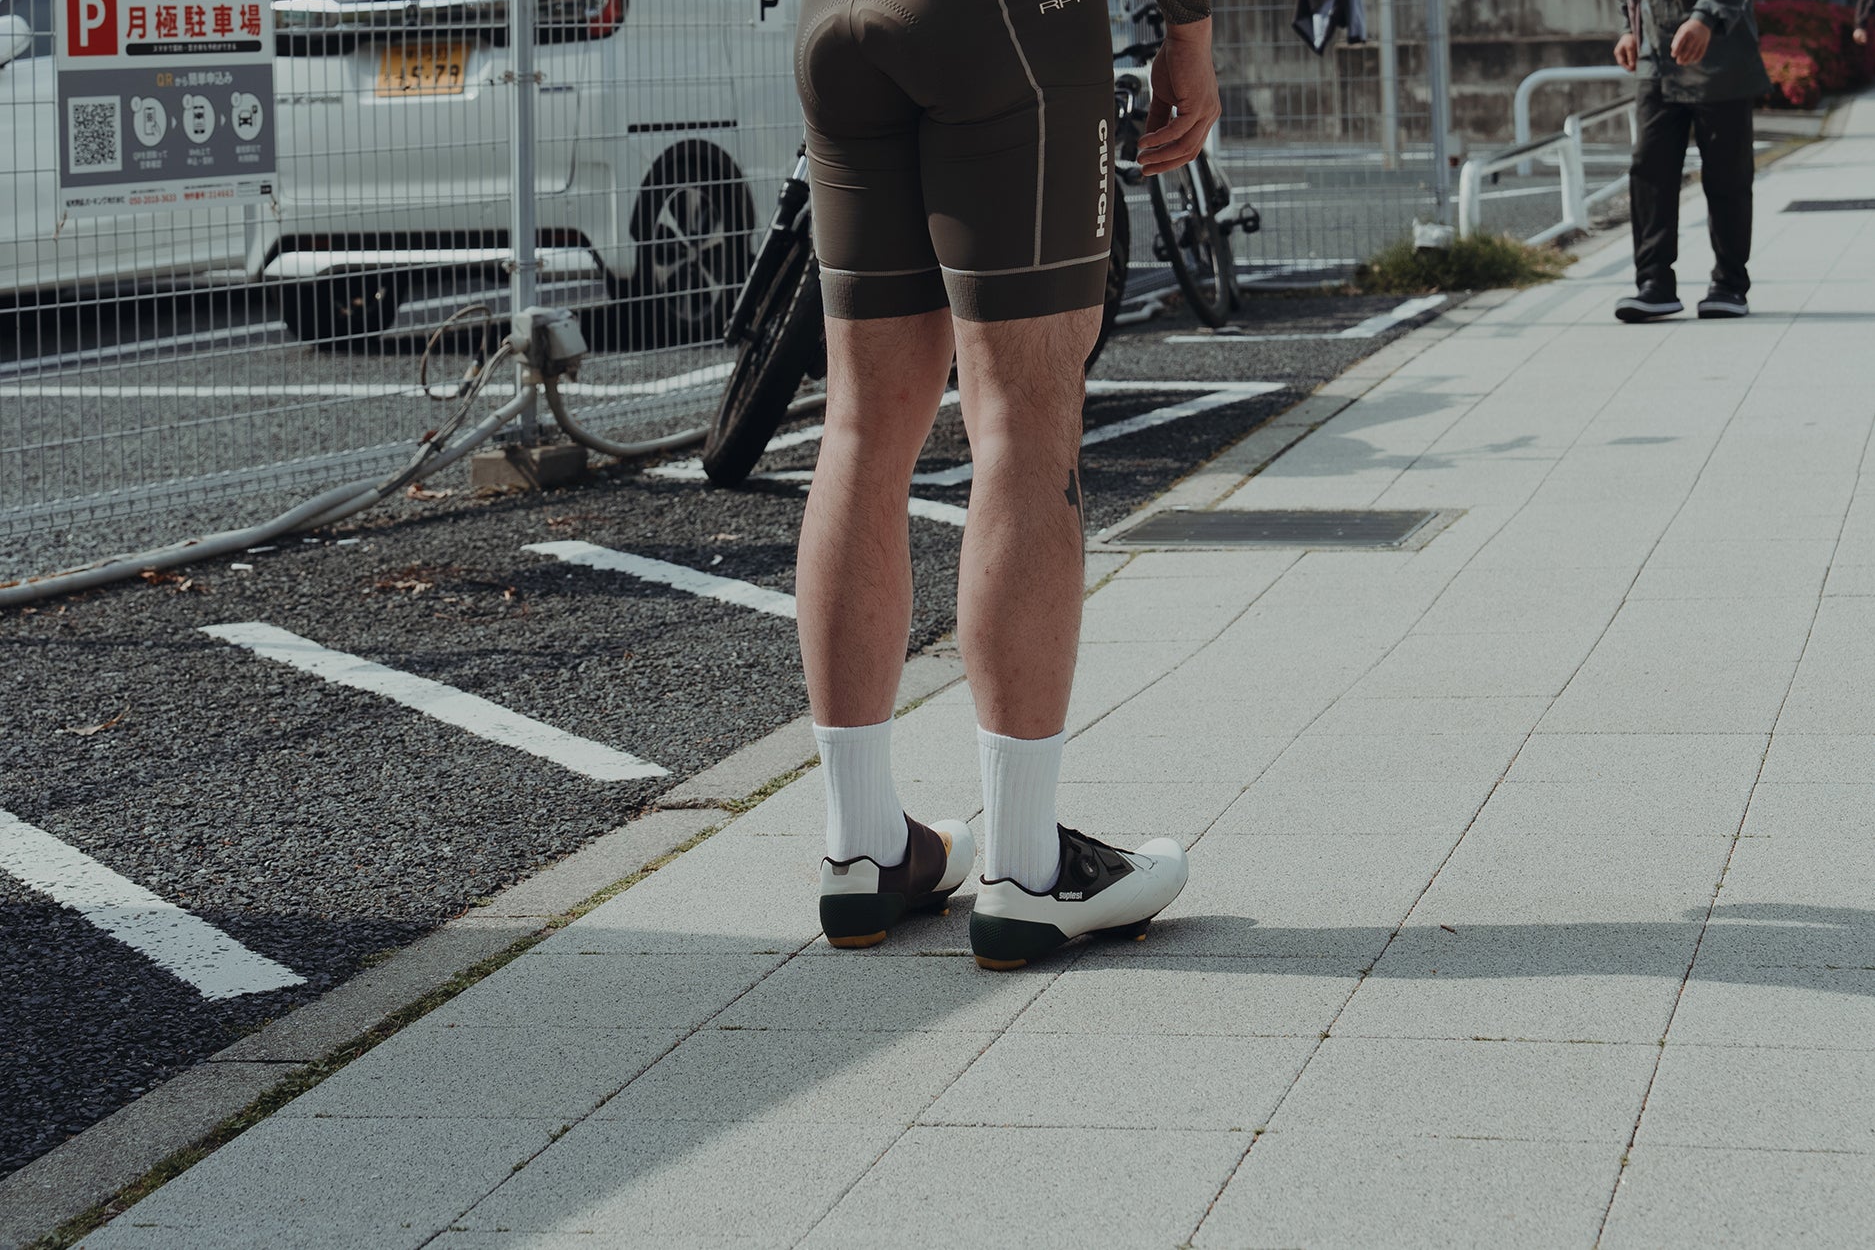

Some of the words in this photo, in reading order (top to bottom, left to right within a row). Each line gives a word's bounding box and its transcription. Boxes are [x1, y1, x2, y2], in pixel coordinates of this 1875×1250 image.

[126, 4, 261, 40] 月極駐車場
